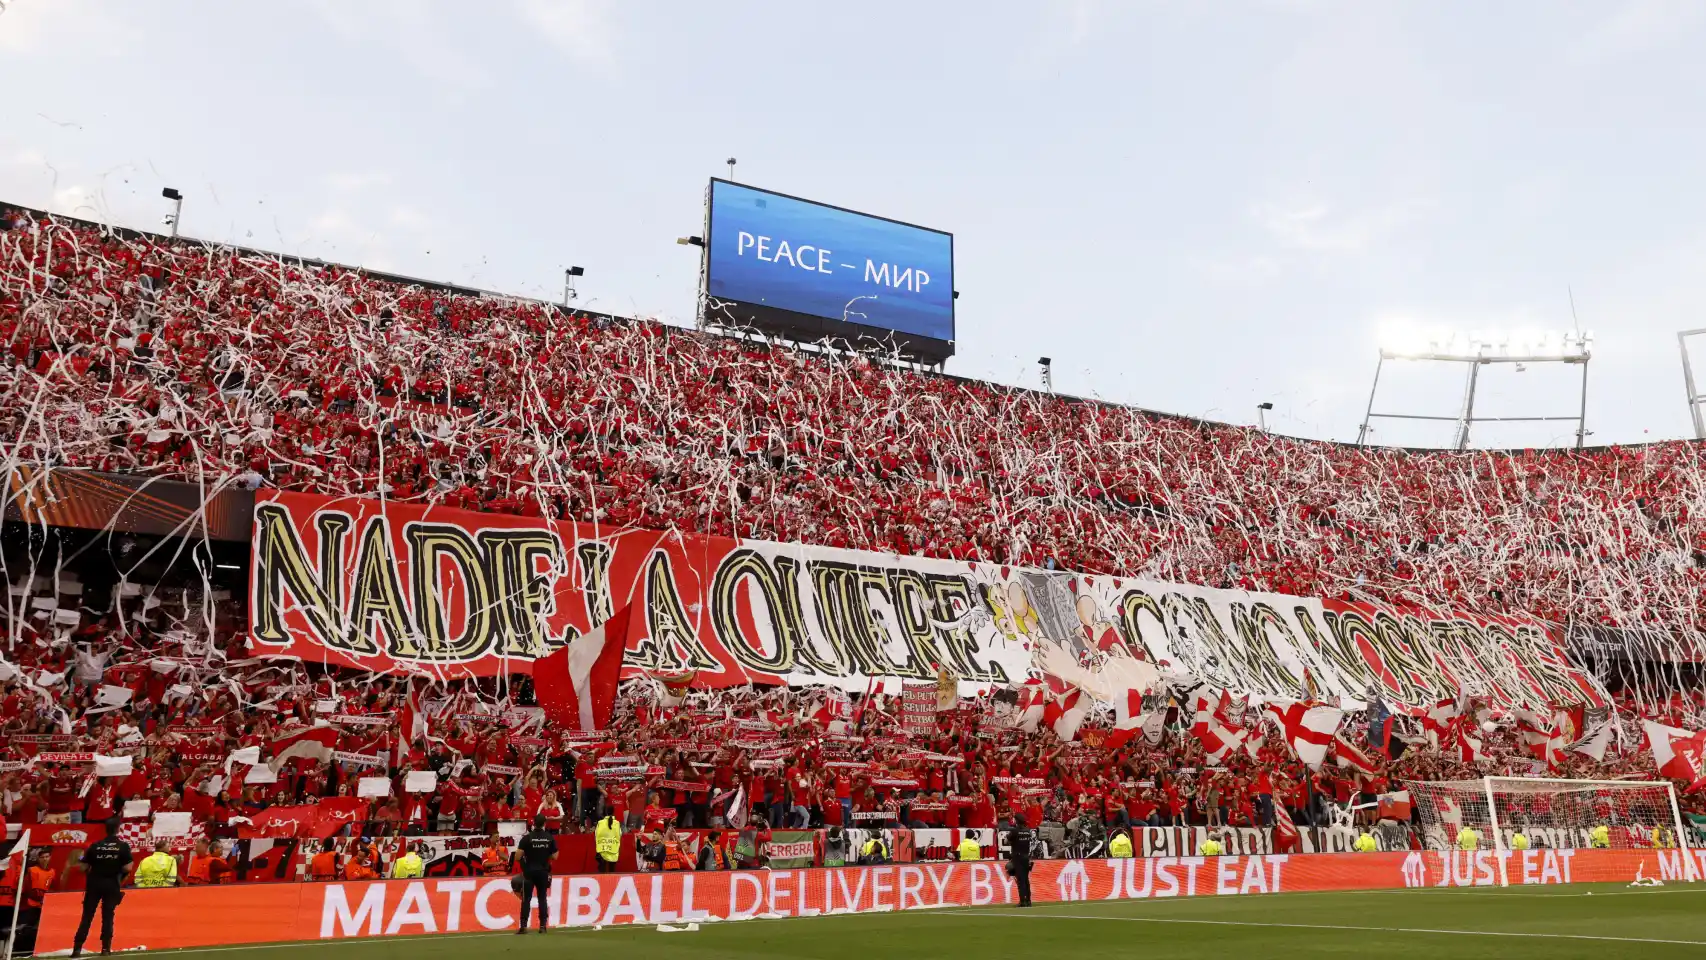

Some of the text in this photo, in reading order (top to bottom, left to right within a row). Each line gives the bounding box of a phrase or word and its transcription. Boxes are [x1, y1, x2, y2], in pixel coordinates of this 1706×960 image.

[737, 231, 833, 275] PEACE
[863, 258, 930, 293] МИР
[253, 503, 583, 660] NADIE
[578, 539, 724, 672] LA
[903, 690, 916, 700] EL
[181, 753, 222, 761] ALGABA
[994, 776, 1045, 785] BIRIS NORTE
[770, 842, 813, 857] ERRERA
[1435, 849, 1575, 886] JUST EAT
[1105, 854, 1289, 900] JUST EAT
[320, 863, 1016, 938] MATCHBALL DELIVERY BY
